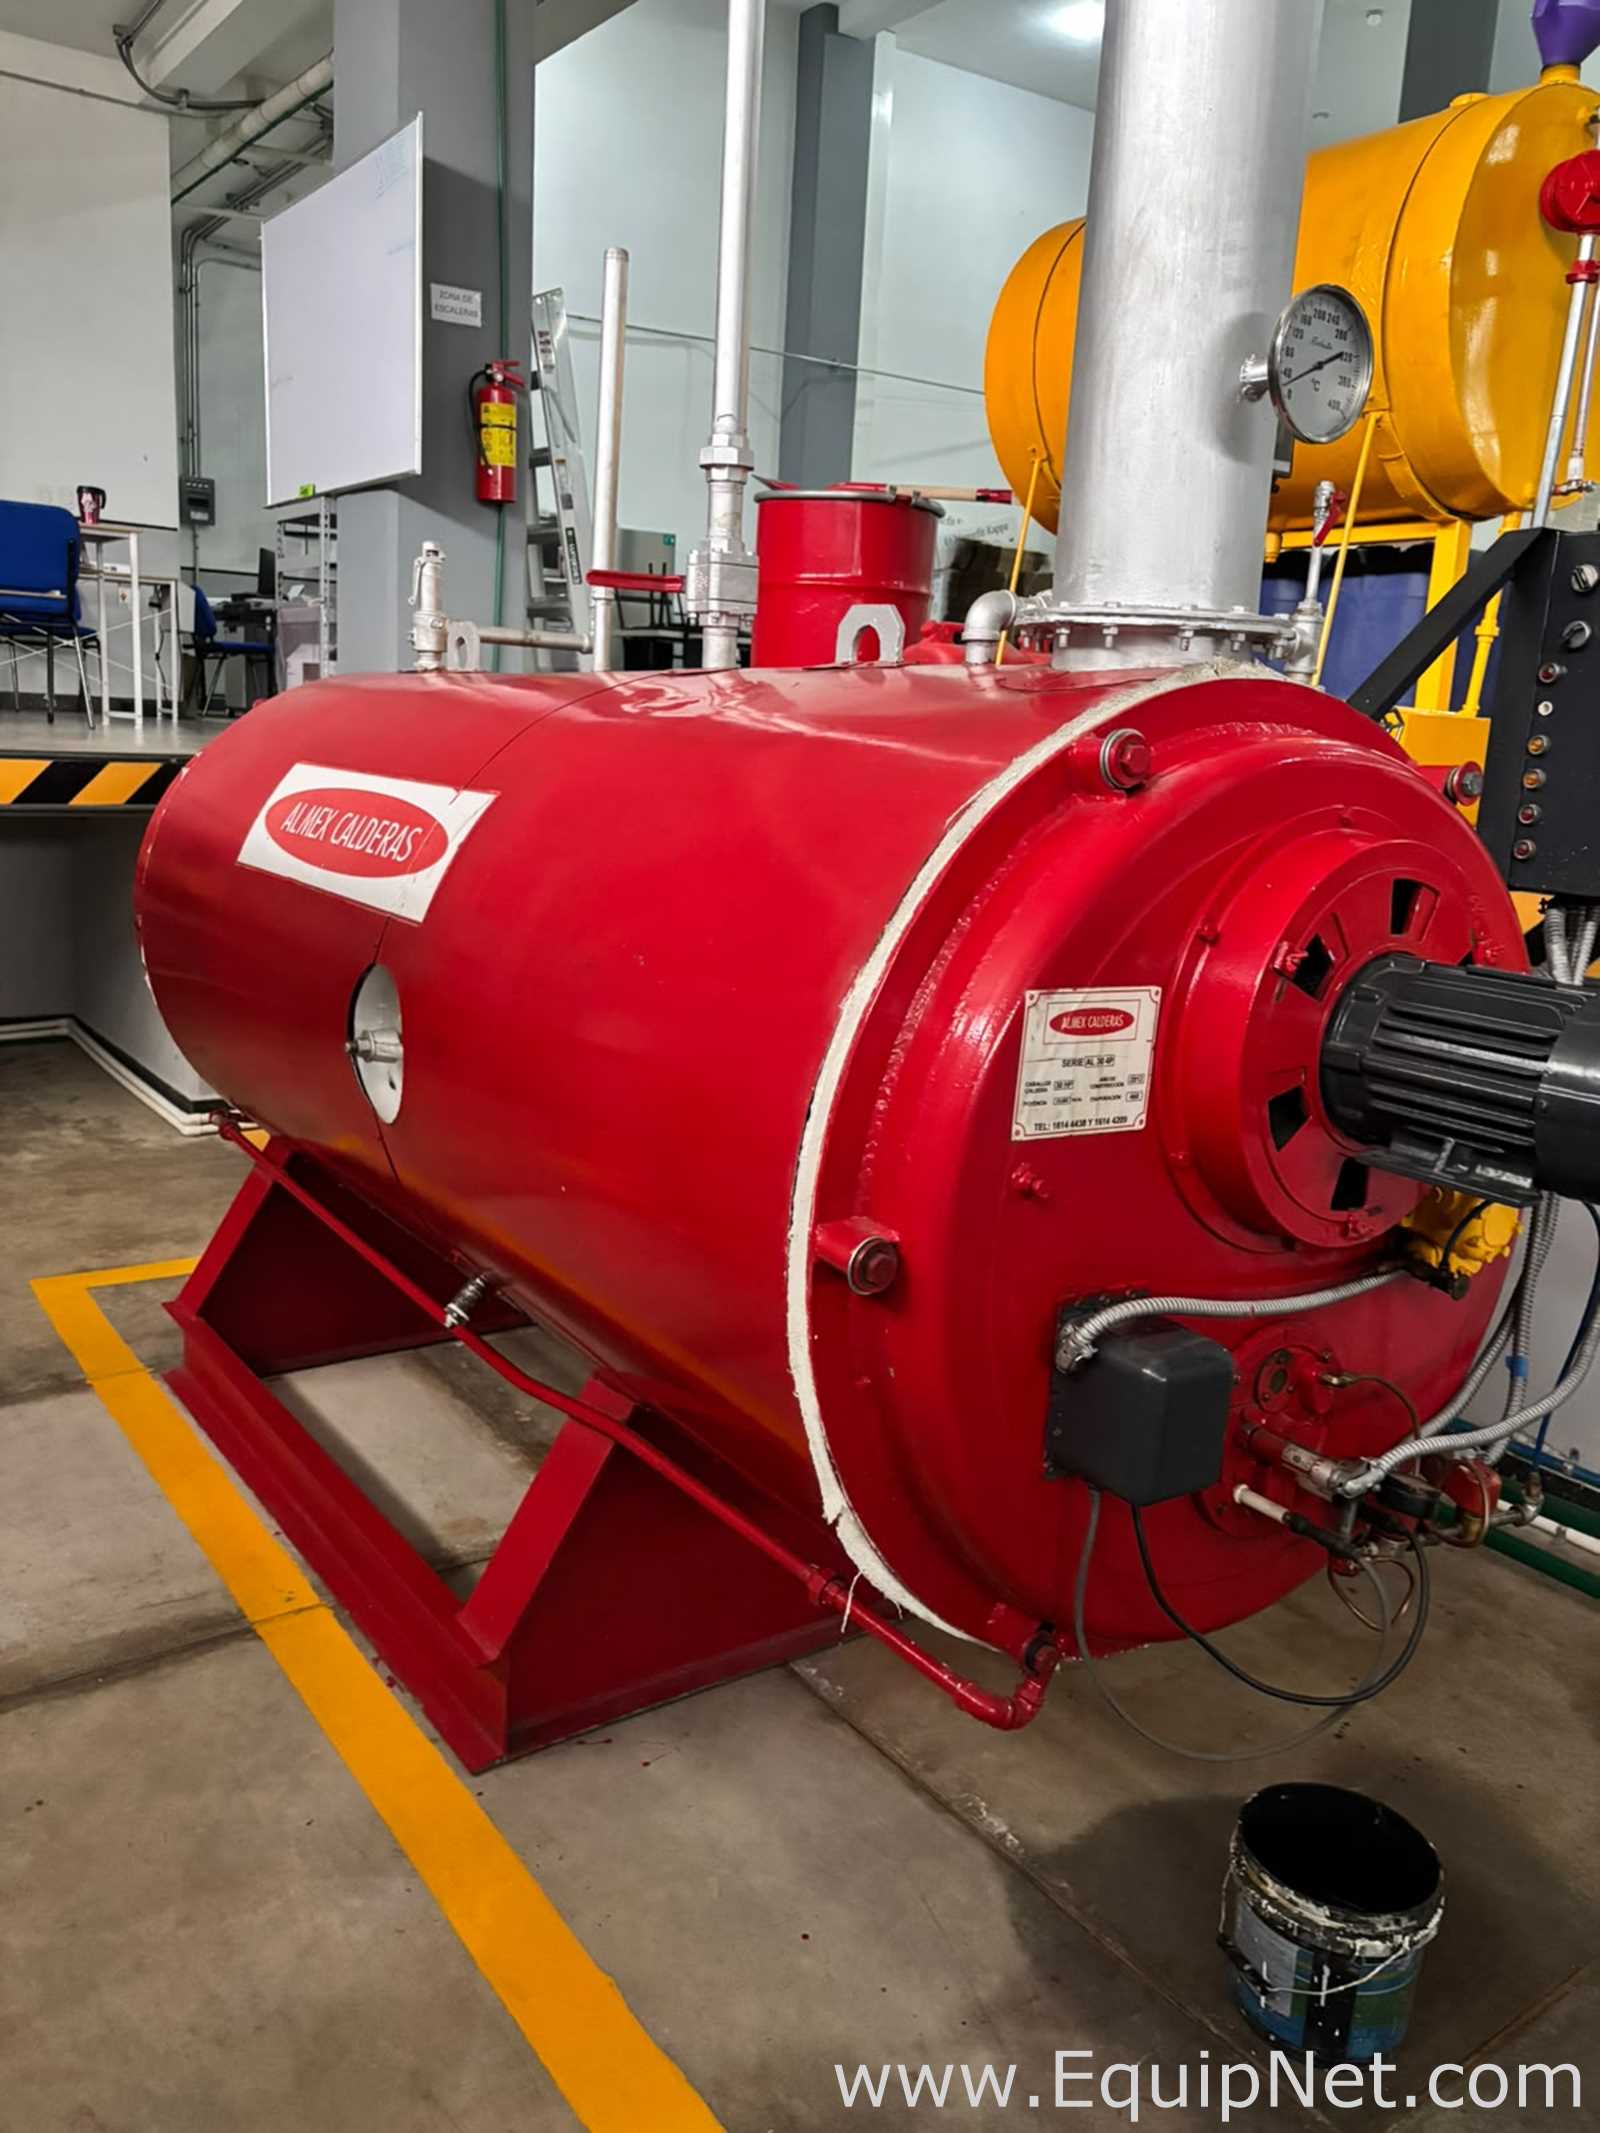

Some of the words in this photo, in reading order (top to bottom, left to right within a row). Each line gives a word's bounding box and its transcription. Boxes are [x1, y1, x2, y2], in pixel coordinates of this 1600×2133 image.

[1313, 308, 1327, 321] 200
[1326, 312, 1341, 326] 240
[280, 801, 340, 841] ALMEX
[330, 812, 424, 862] CALDERAS
[1061, 1016, 1087, 1030] ALMEX
[1087, 1014, 1125, 1028] CALDERAS
[1062, 1059, 1083, 1067] SERIE
